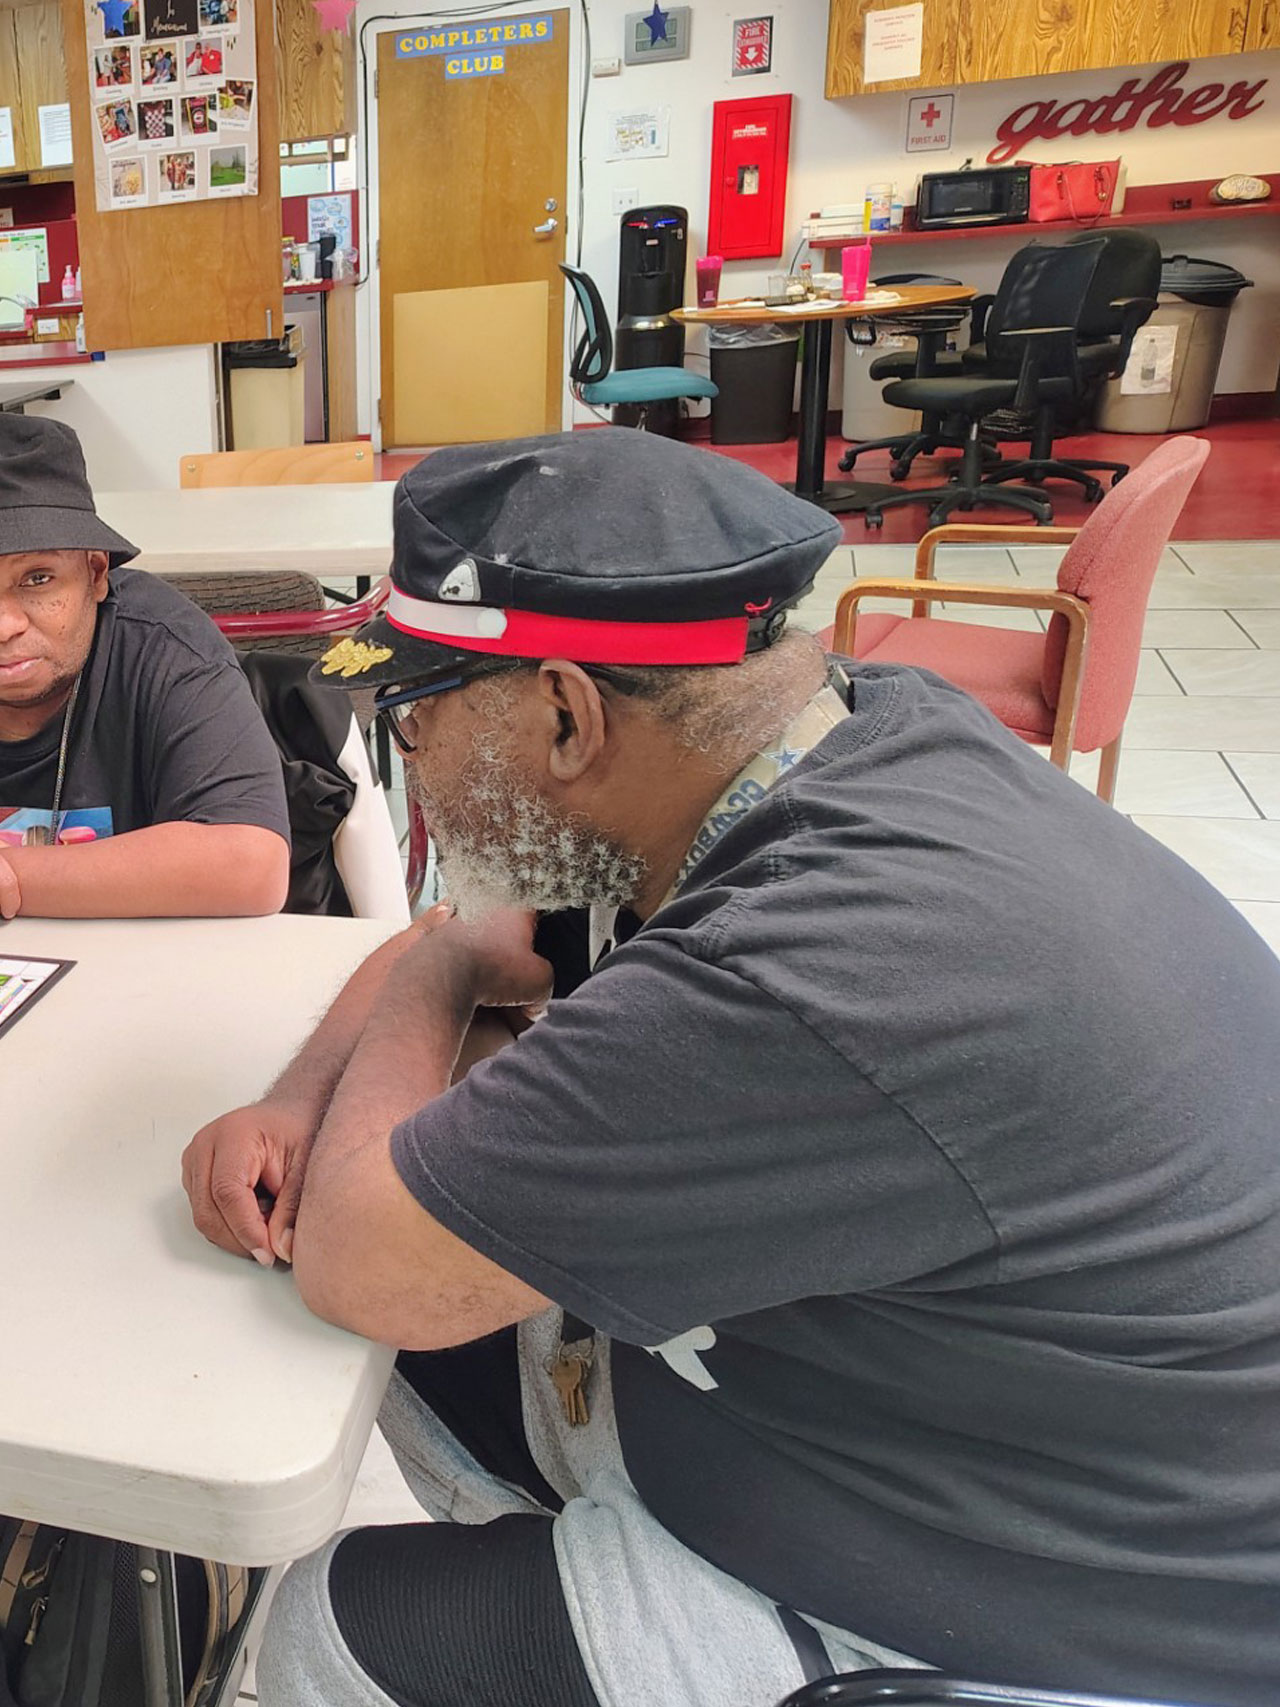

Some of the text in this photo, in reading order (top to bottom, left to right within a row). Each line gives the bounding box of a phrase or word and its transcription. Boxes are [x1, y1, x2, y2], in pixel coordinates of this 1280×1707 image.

[399, 21, 548, 53] COMPLETERS
[745, 25, 760, 37] FIRE
[447, 54, 504, 75] CLUB
[986, 61, 1268, 165] gather
[911, 134, 946, 145] FIRST AID
